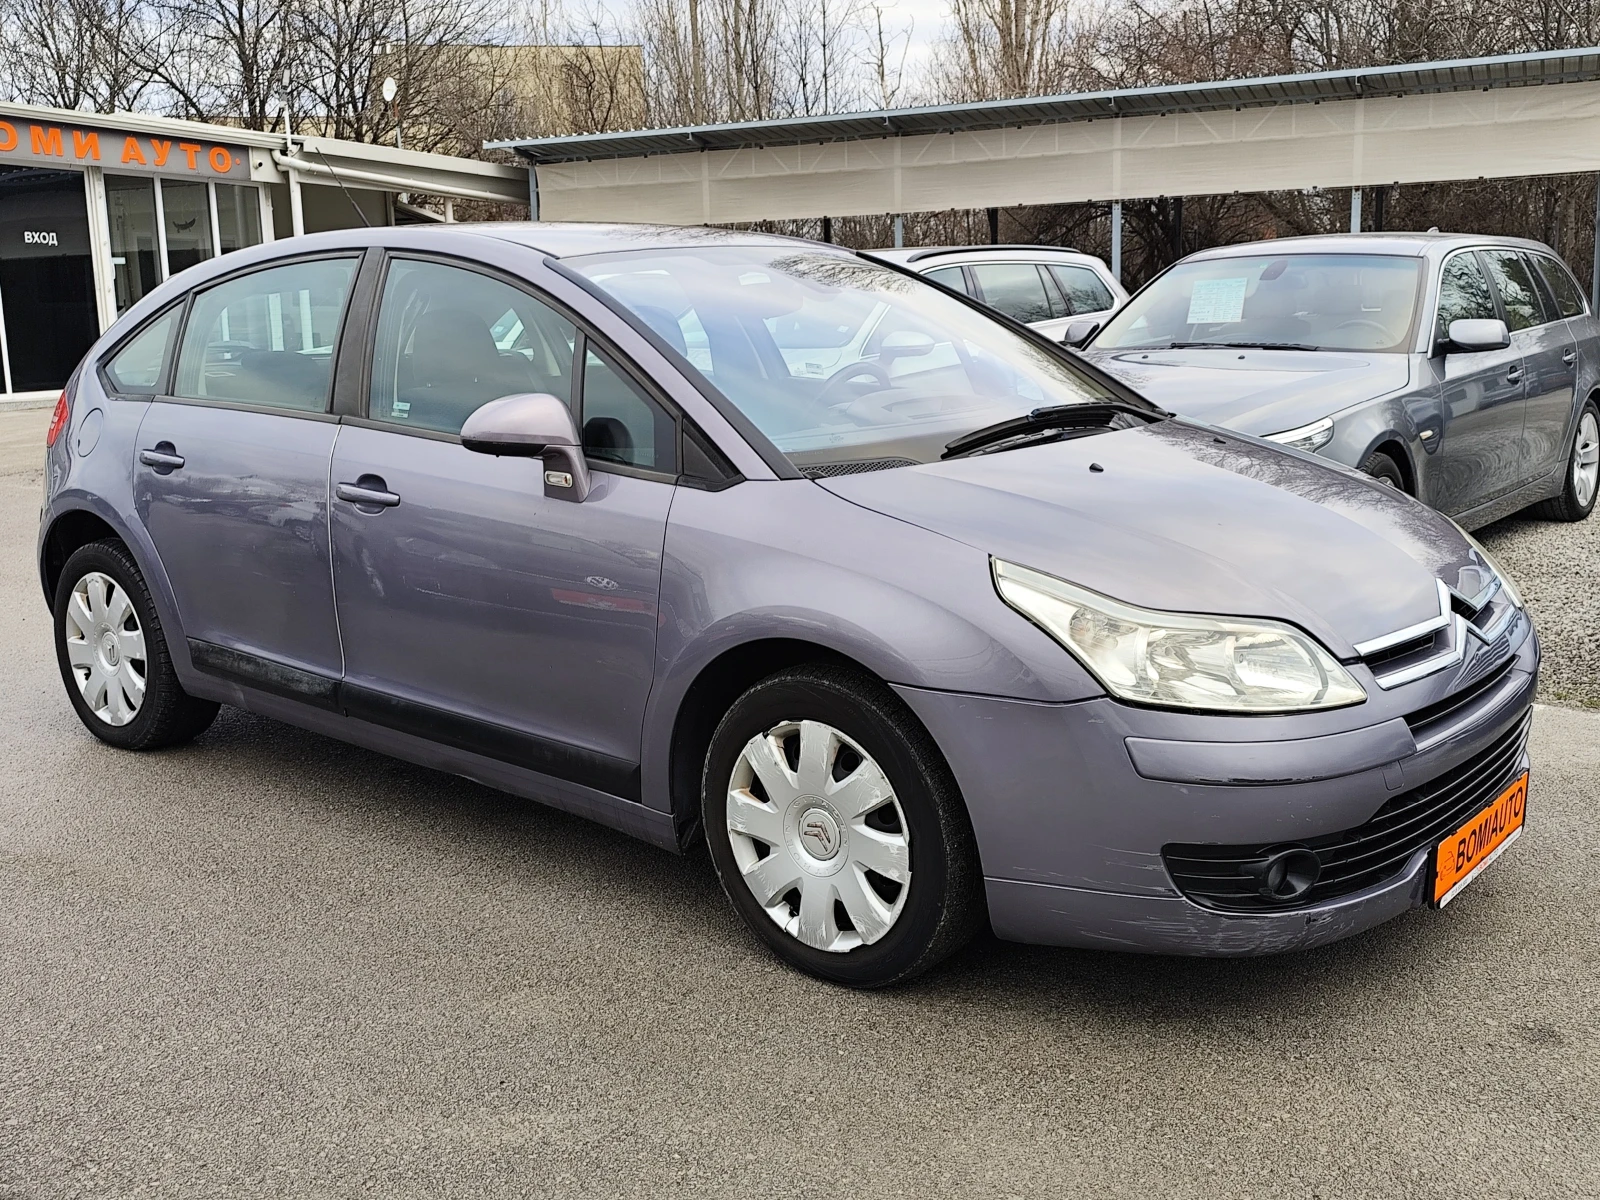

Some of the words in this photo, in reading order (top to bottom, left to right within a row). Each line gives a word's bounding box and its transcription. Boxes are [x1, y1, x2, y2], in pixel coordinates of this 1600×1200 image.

[121, 136, 232, 174] АУТО
[24, 231, 58, 247] ВХОД
[1455, 785, 1523, 875] BOMIAUTO
